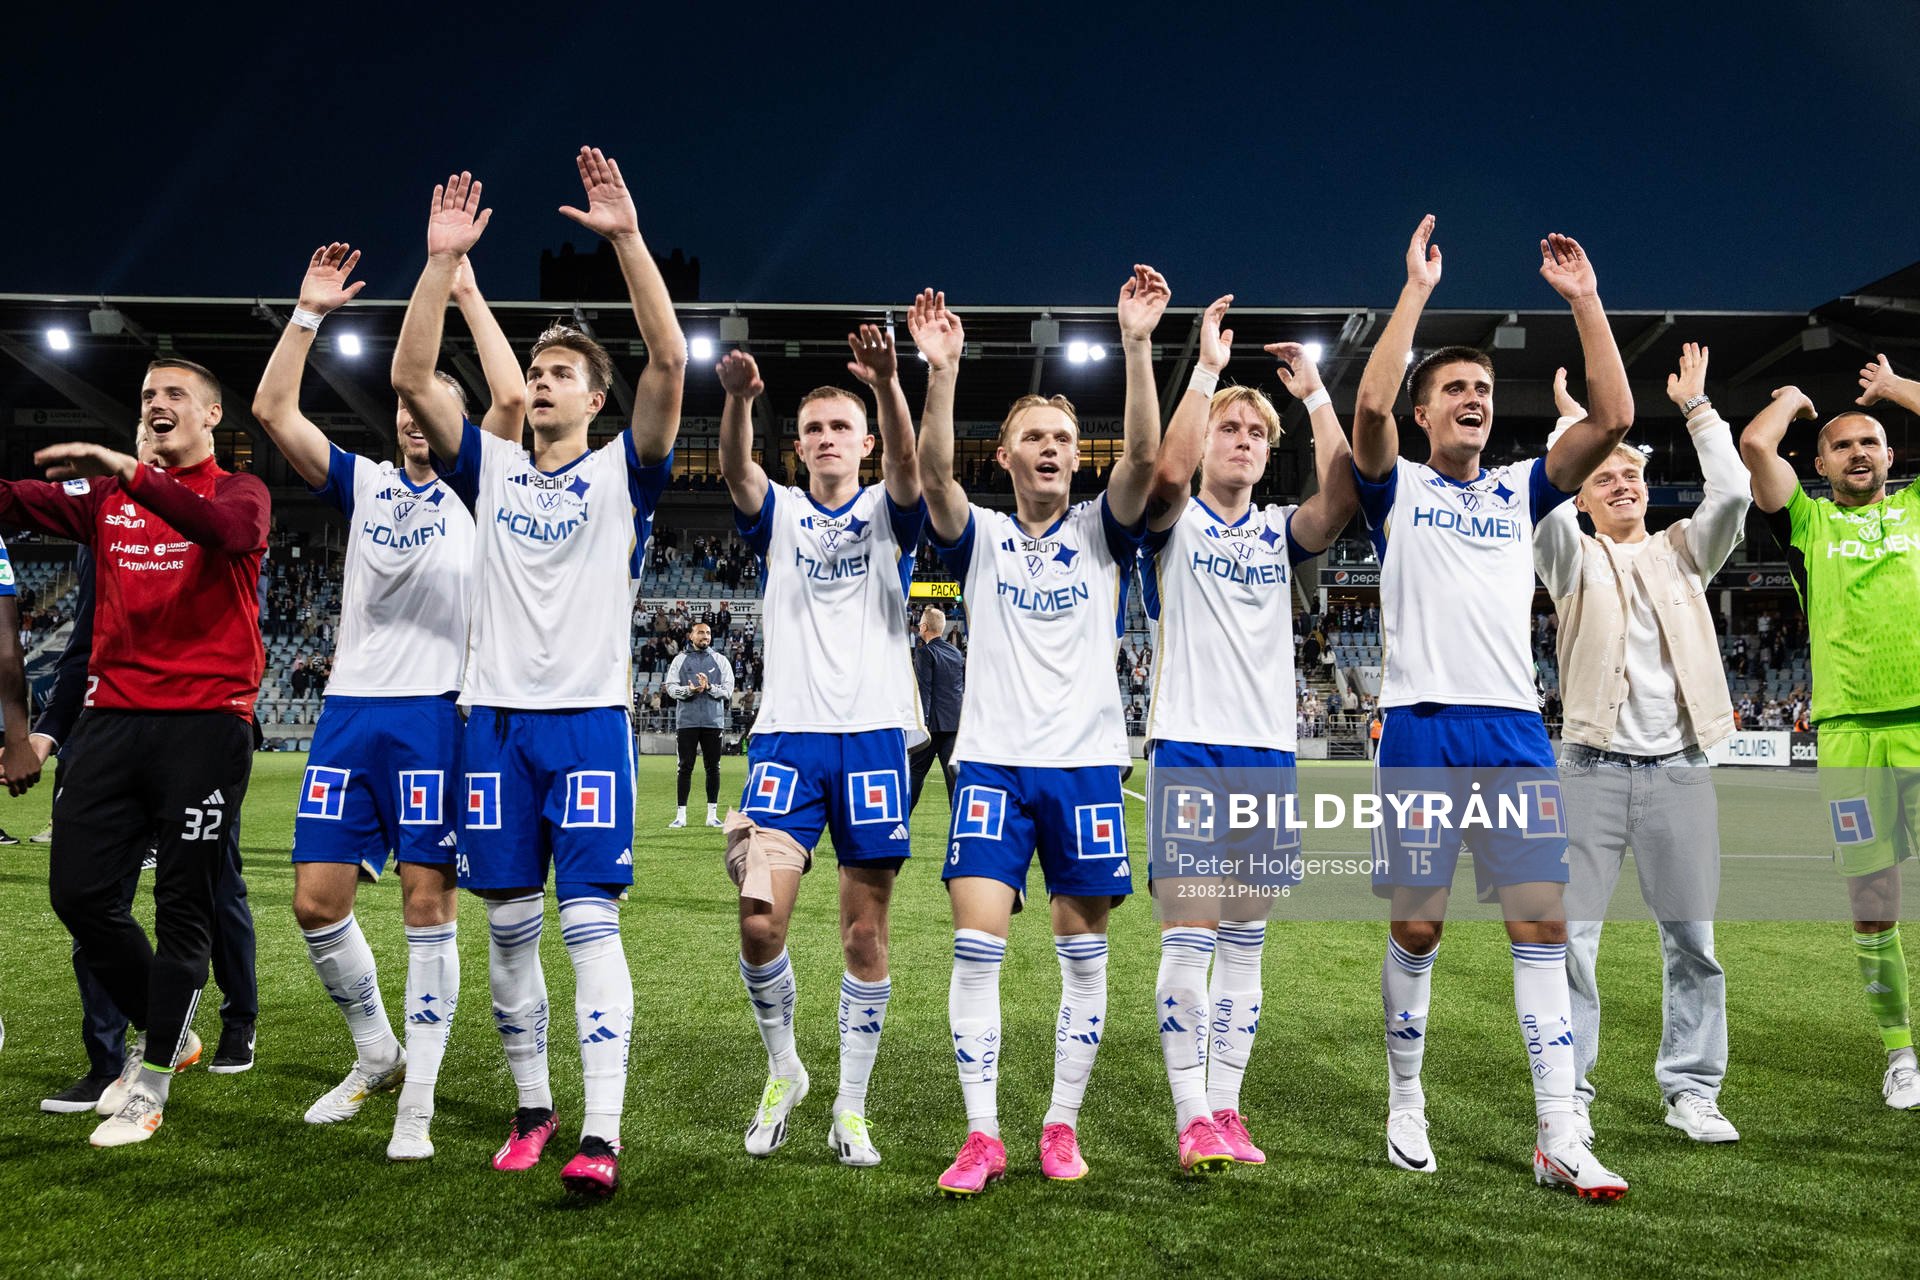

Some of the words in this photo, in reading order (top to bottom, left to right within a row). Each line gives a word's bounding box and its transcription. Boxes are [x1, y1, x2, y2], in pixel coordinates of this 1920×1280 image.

[1081, 421, 1124, 433] UMC
[362, 518, 446, 549] HOLMEN
[1221, 527, 1261, 538] adium
[1413, 506, 1521, 542] HOLMEN
[110, 540, 150, 555] HLMEN
[166, 541, 194, 549] LUND
[1021, 541, 1060, 553] adium
[1827, 532, 1920, 559] HOLMEN
[117, 558, 184, 571] LATINMCARS
[1193, 551, 1287, 585] HOLMEN
[1351, 574, 1381, 584] peps
[1766, 576, 1790, 586] pep
[1729, 739, 1775, 757] HOLMEN
[1792, 742, 1818, 760] stadi
[181, 807, 222, 841] 32
[950, 842, 960, 866] 3
[1165, 841, 1178, 862] 8
[1408, 850, 1432, 875] 15
[1057, 1007, 1071, 1042] Ocab
[1212, 998, 1233, 1033] Ocab
[1522, 1015, 1543, 1055] Ocab
[982, 1051, 995, 1082] Oca
